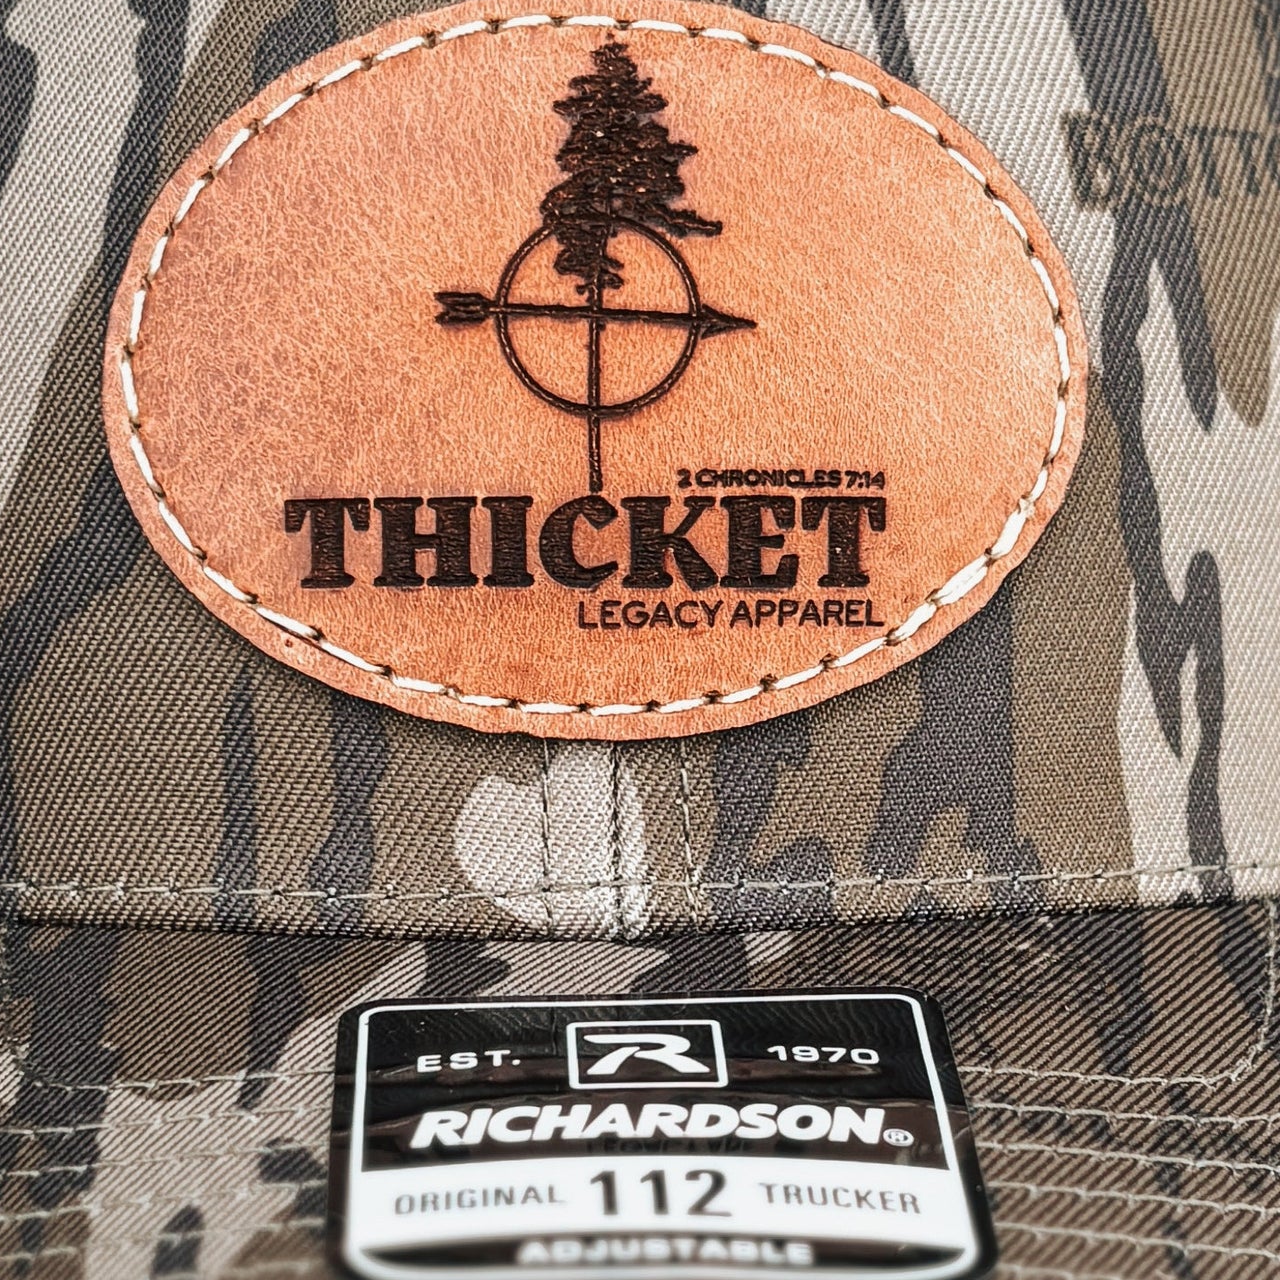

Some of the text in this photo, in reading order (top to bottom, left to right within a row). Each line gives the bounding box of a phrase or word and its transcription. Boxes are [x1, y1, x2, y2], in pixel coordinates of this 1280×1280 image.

[677, 468, 886, 490] 2 CHRONICLES 7:14
[284, 494, 887, 591] THICKET
[578, 599, 885, 629] LEGACY APPAREL
[417, 1050, 520, 1073] EST.
[767, 1045, 880, 1065] 1970
[394, 1170, 922, 1218] ORIGINAL 112 TRUCKER
[518, 1239, 812, 1265] ADJUSTABLE
